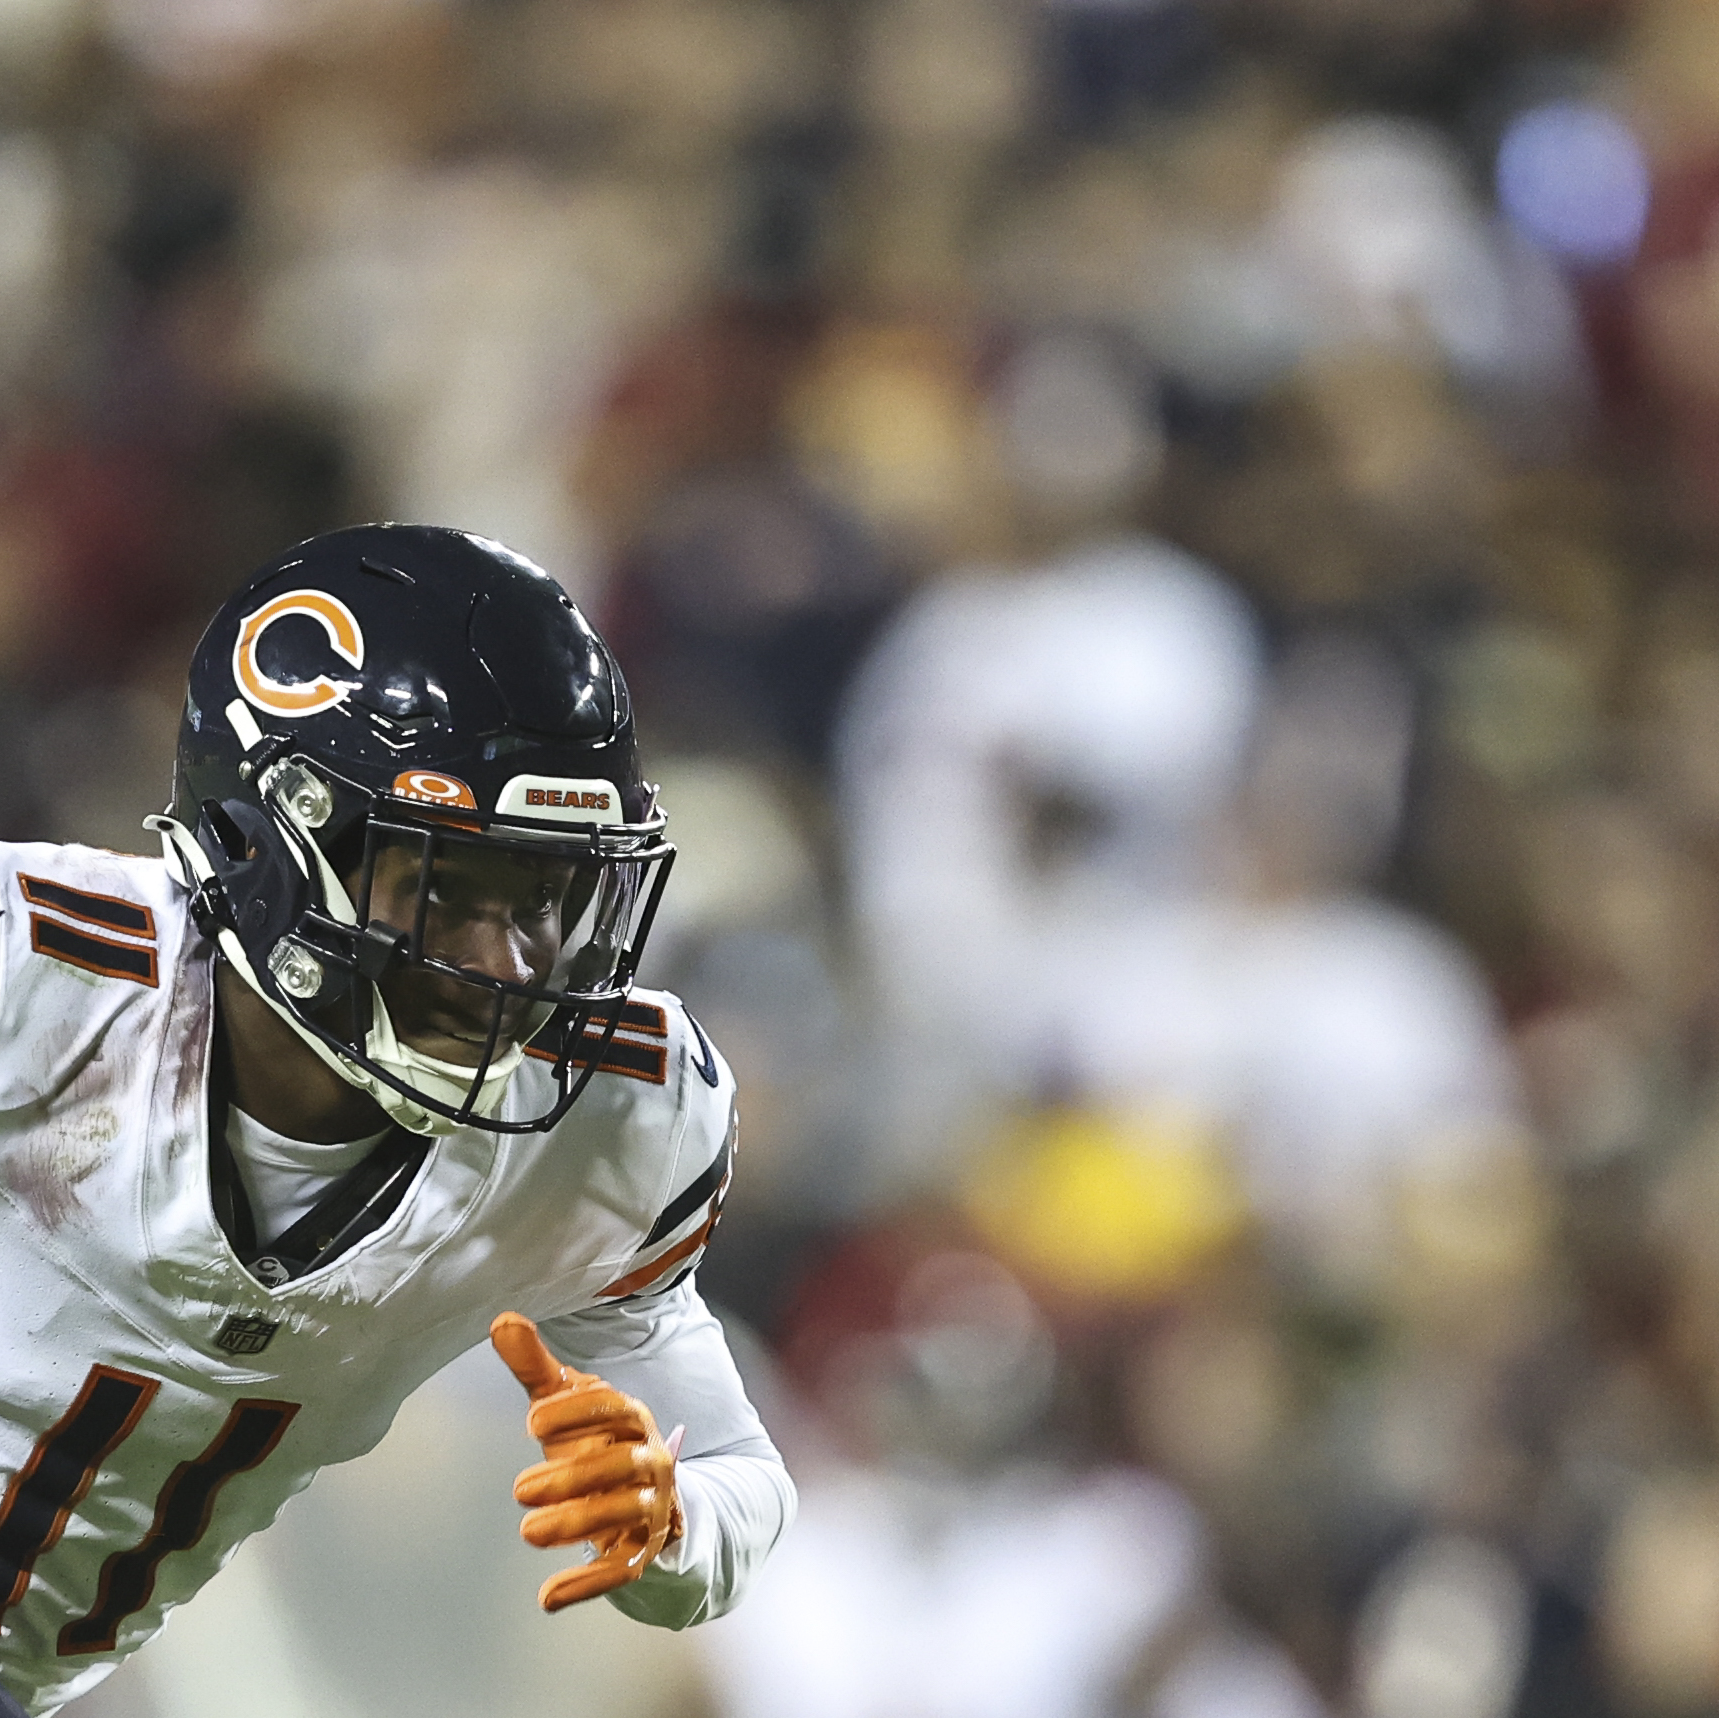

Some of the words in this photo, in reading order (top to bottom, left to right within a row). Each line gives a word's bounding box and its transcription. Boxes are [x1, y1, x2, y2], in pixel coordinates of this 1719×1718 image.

[232, 589, 364, 718] C
[526, 788, 610, 810] BEARS
[17, 872, 159, 987] 11
[220, 1330, 270, 1353] NFL
